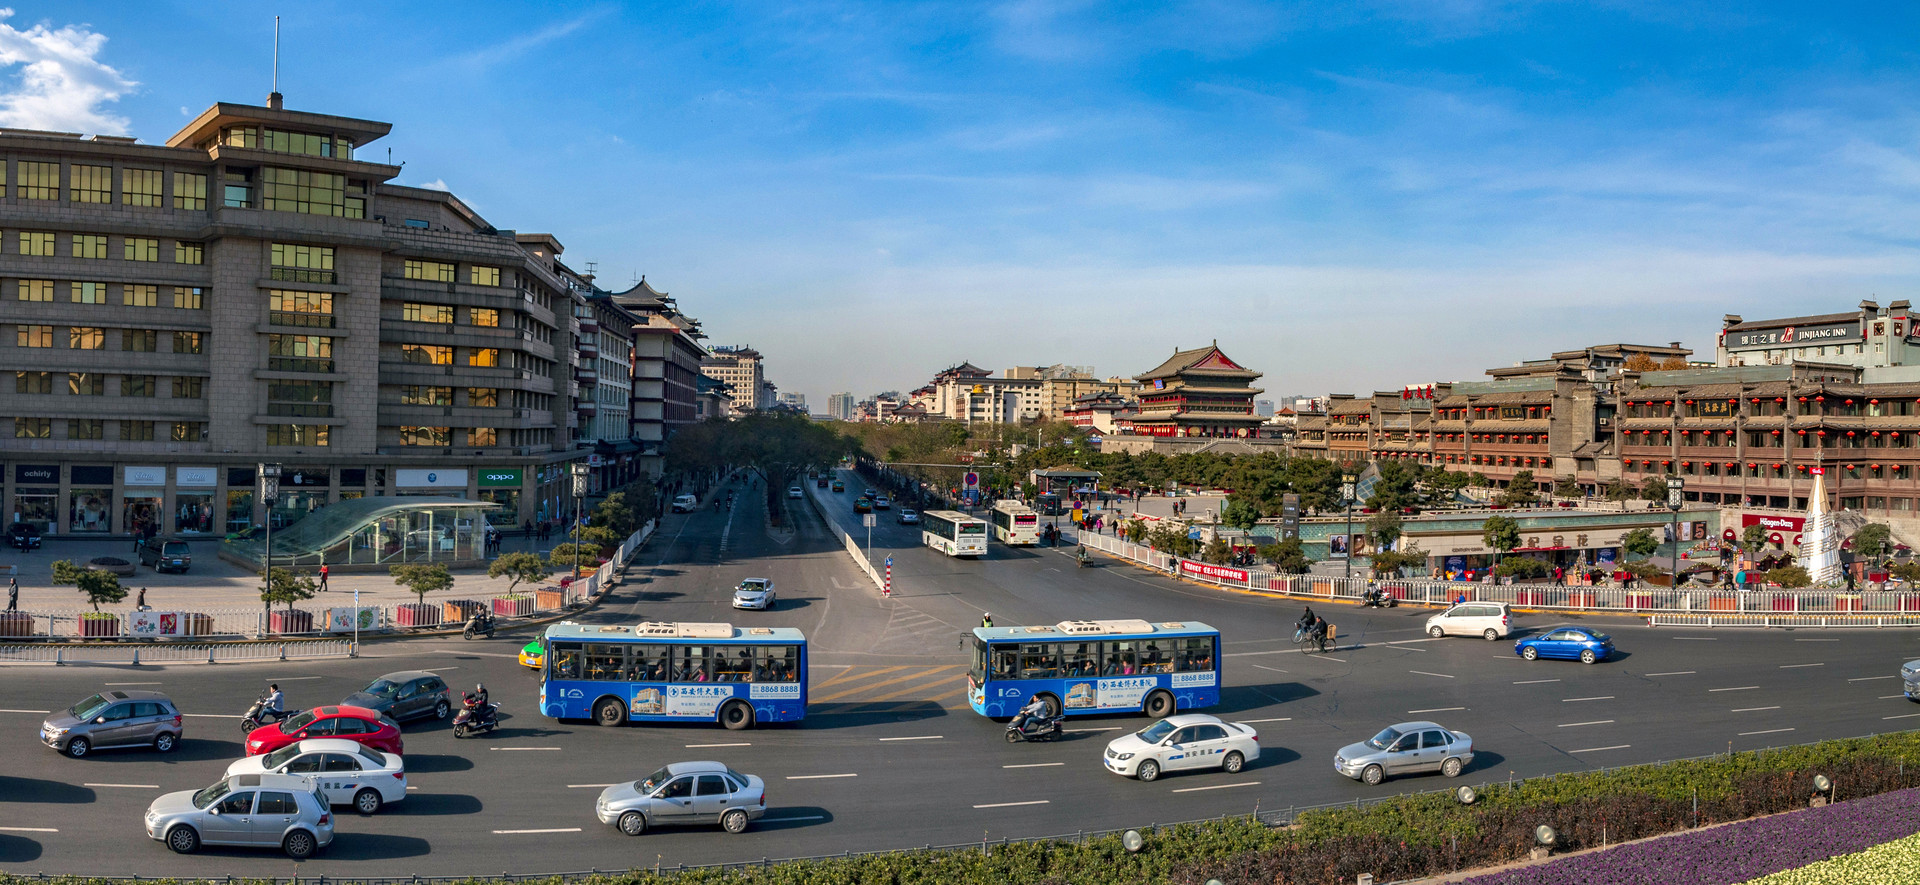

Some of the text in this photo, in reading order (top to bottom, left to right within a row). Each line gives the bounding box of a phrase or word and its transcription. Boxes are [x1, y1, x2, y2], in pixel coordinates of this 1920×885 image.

[1741, 333, 1777, 345] 锦江之星
[1798, 328, 1847, 341] JINJIANG INN
[24, 470, 52, 479] ochirly
